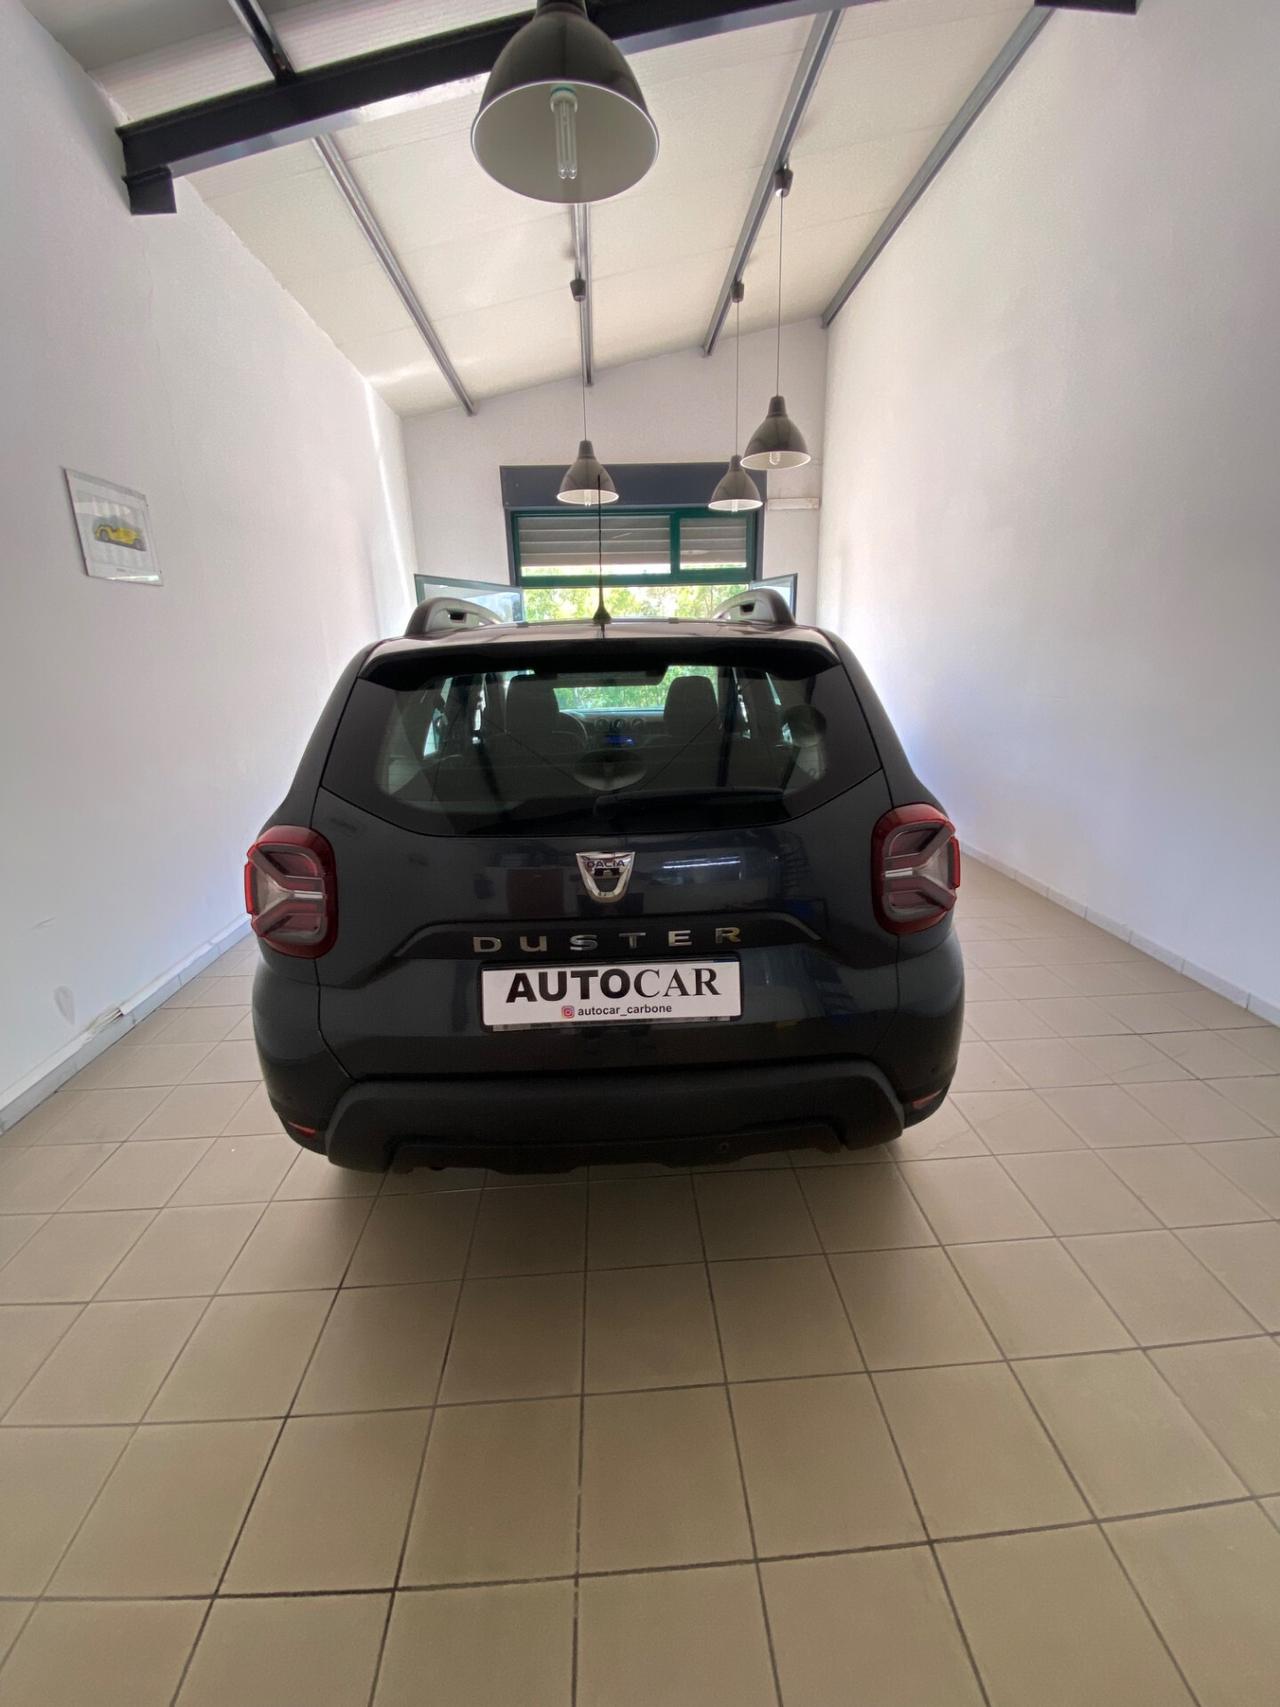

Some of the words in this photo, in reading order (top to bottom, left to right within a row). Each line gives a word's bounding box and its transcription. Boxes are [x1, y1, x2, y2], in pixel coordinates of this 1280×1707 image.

[586, 859, 625, 868] DACIA
[473, 927, 741, 953] DUSTER
[506, 968, 721, 1003] AUTOCAR
[577, 1004, 672, 1017] autocar_carbone
